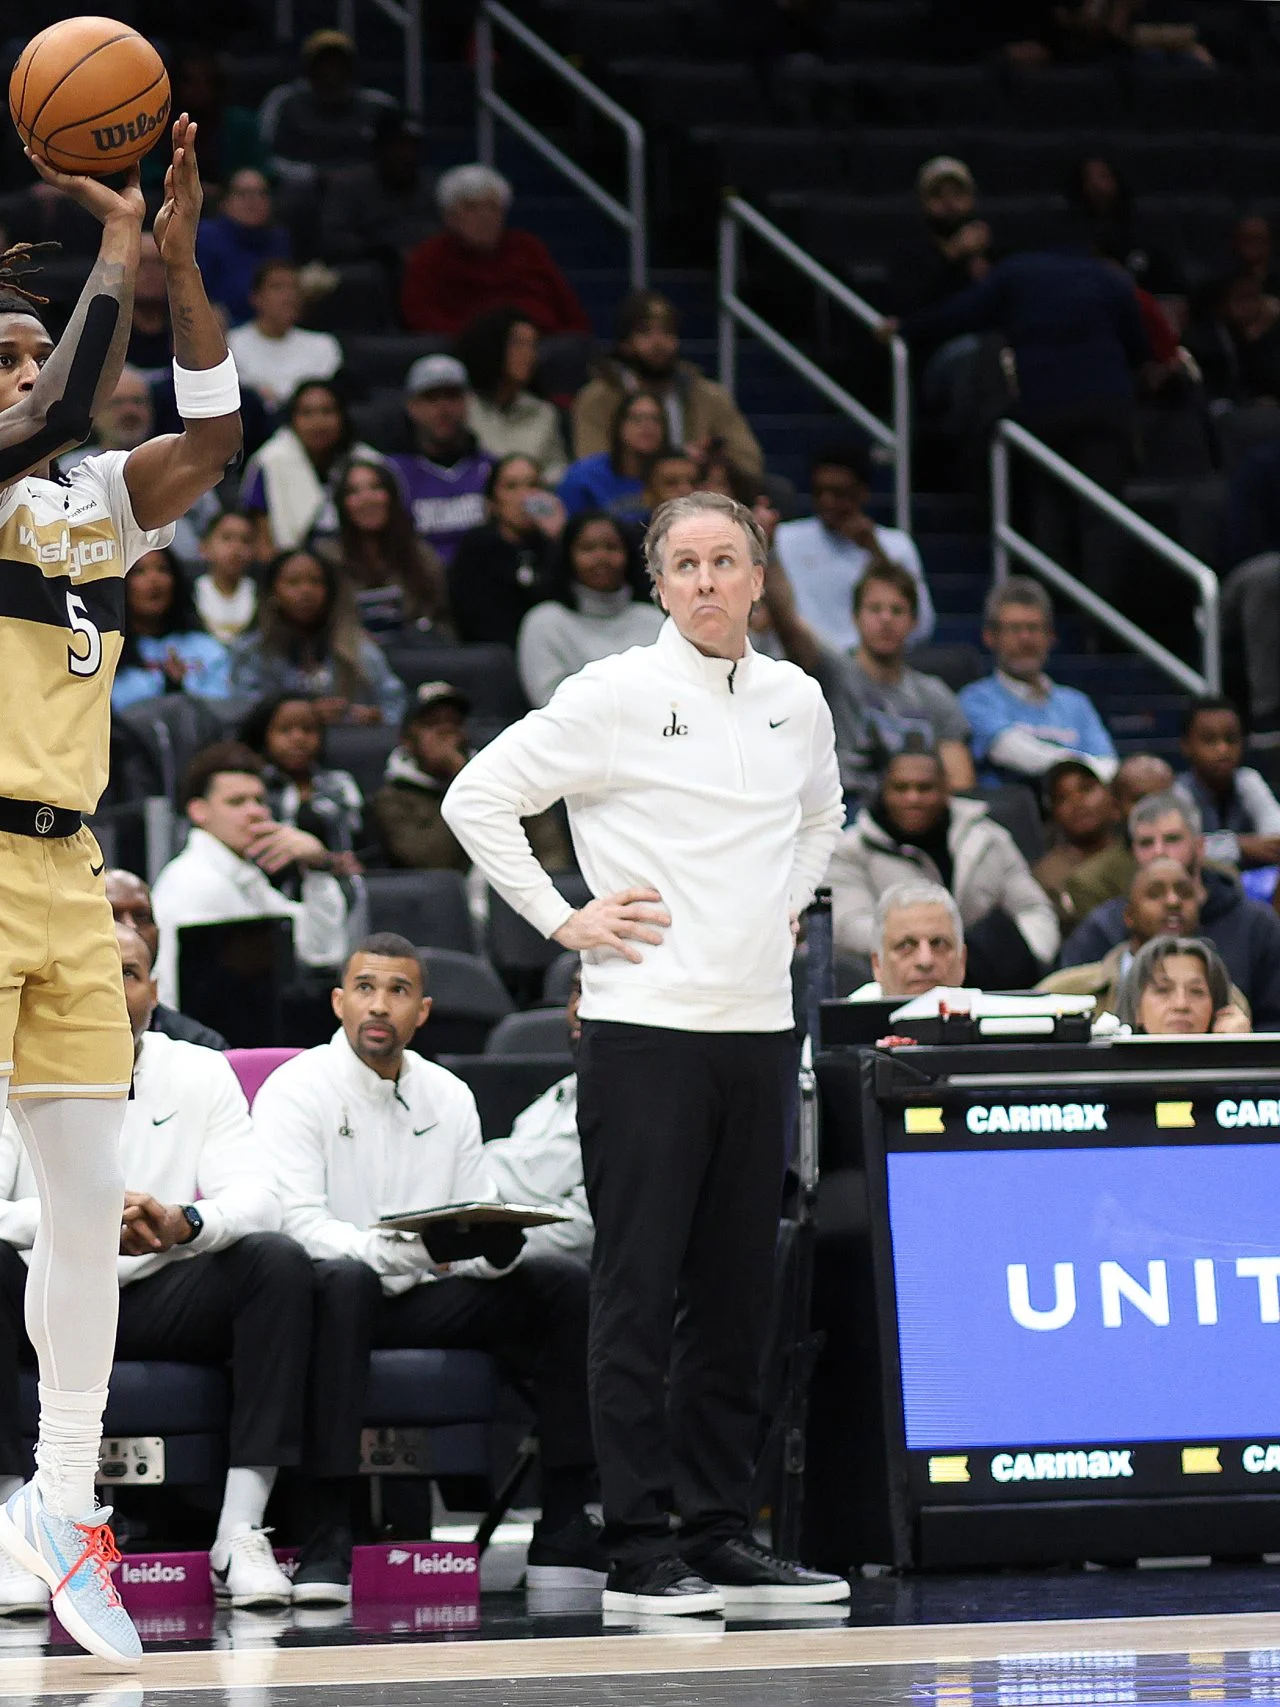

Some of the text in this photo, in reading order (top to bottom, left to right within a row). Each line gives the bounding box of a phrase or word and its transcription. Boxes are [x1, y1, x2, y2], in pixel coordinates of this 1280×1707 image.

[66, 590, 102, 677] 5
[1006, 1257, 1280, 1331] UNIT
[122, 1562, 186, 1583] leidos
[413, 1552, 477, 1574] leidos
